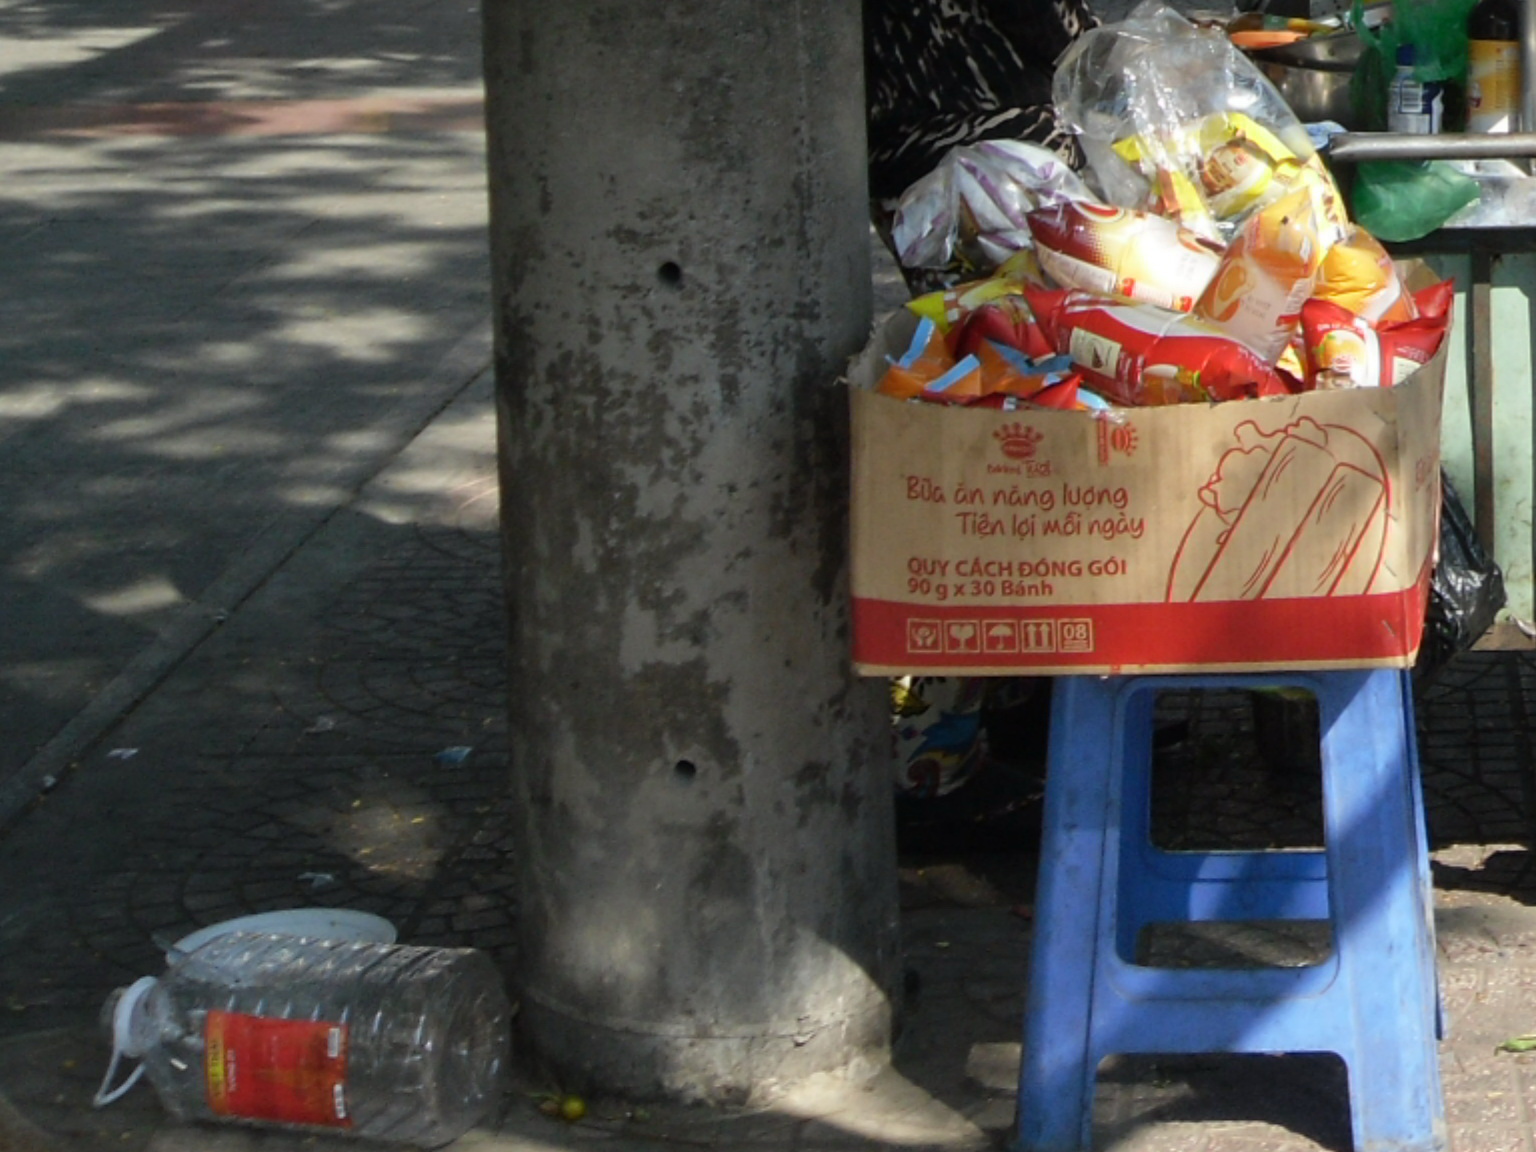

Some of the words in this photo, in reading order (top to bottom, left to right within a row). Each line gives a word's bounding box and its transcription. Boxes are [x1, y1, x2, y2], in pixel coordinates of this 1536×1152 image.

[953, 482, 985, 505] ăn
[992, 485, 1055, 512] năng
[956, 511, 1005, 540] Tiện
[1012, 513, 1037, 541] lợi
[1043, 510, 1082, 538] mỗi
[1088, 512, 1146, 540] ngày
[907, 556, 950, 577] QUY
[955, 555, 1012, 577] CÁCH
[1018, 557, 1083, 578] ĐÓNG
[1087, 557, 1127, 576] GÓI
[907, 577, 931, 595] 90
[935, 583, 949, 601] g
[953, 584, 966, 597] x
[970, 580, 995, 597] 30
[1001, 579, 1053, 597] Bánh
[1063, 623, 1088, 640] 08
